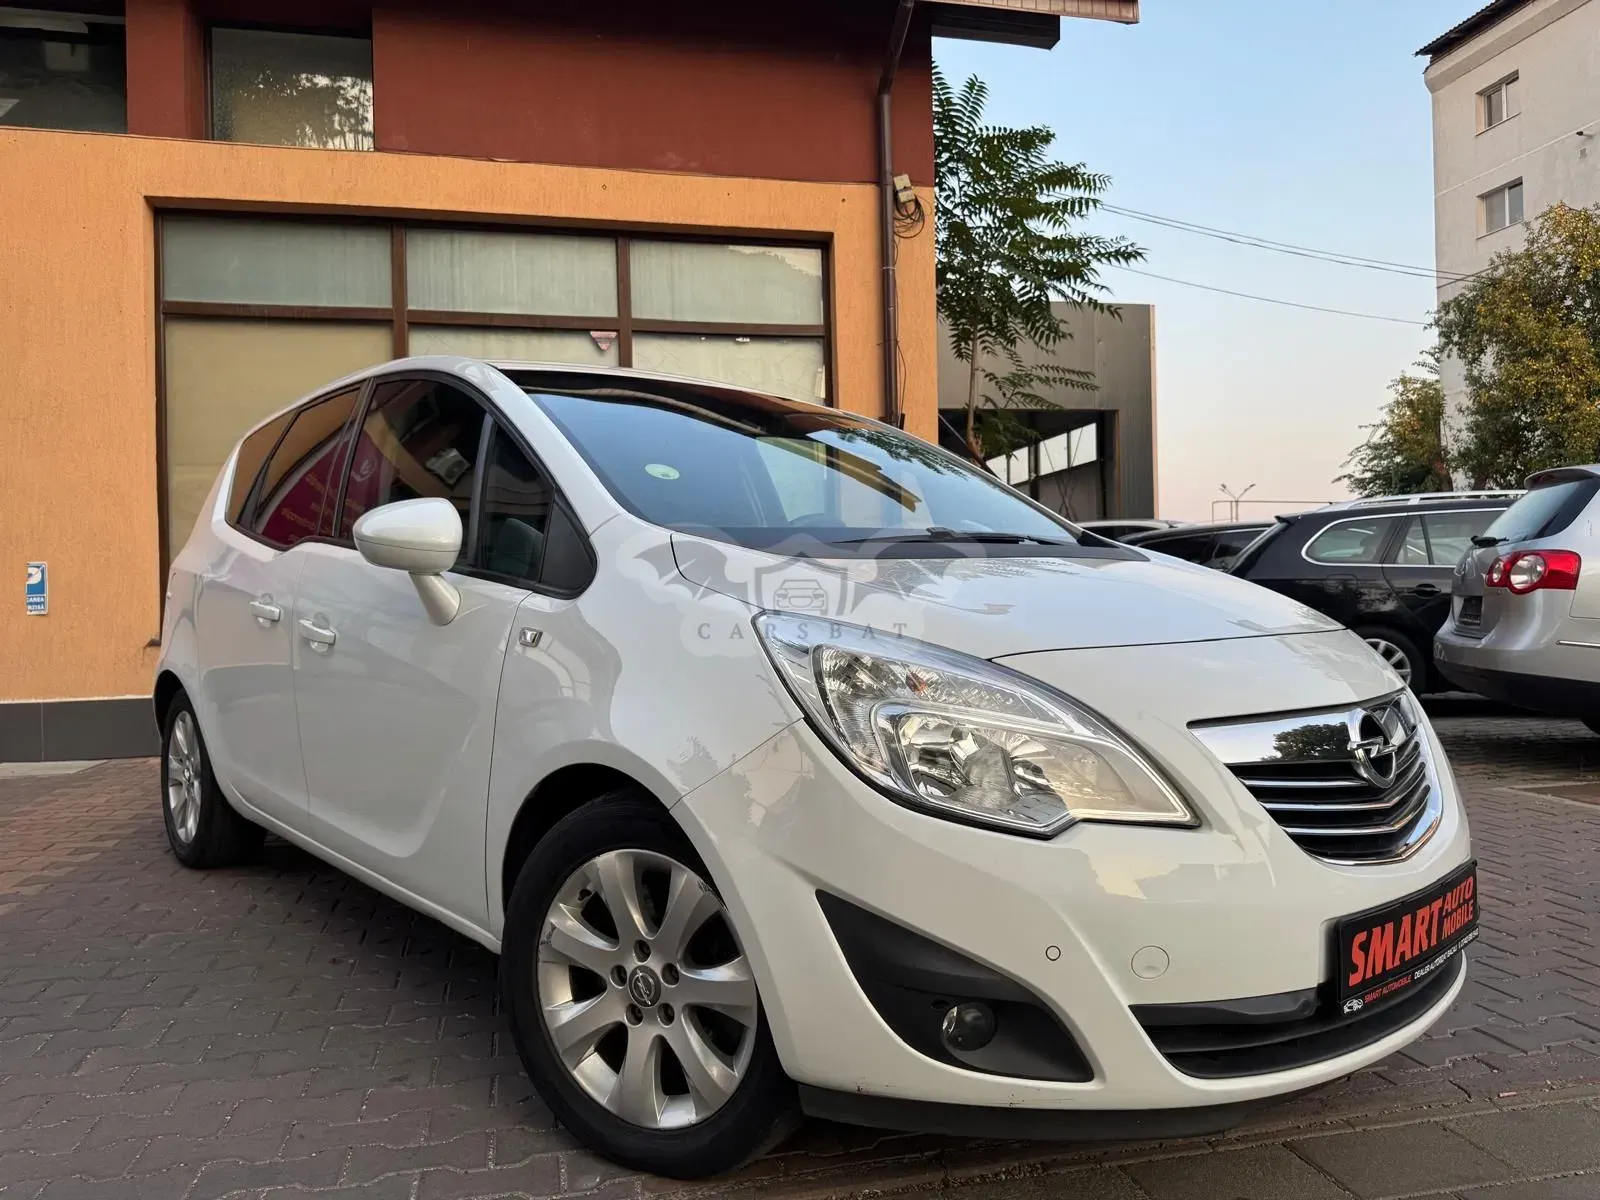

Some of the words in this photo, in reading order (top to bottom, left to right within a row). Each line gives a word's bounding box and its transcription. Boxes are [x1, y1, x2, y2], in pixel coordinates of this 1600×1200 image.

[1442, 876, 1473, 915] AUTO
[1442, 899, 1473, 940] MOBILE
[1349, 896, 1443, 987] SMART
[1364, 988, 1382, 1003] SMART
[1381, 974, 1411, 994] AUTOMOBILE
